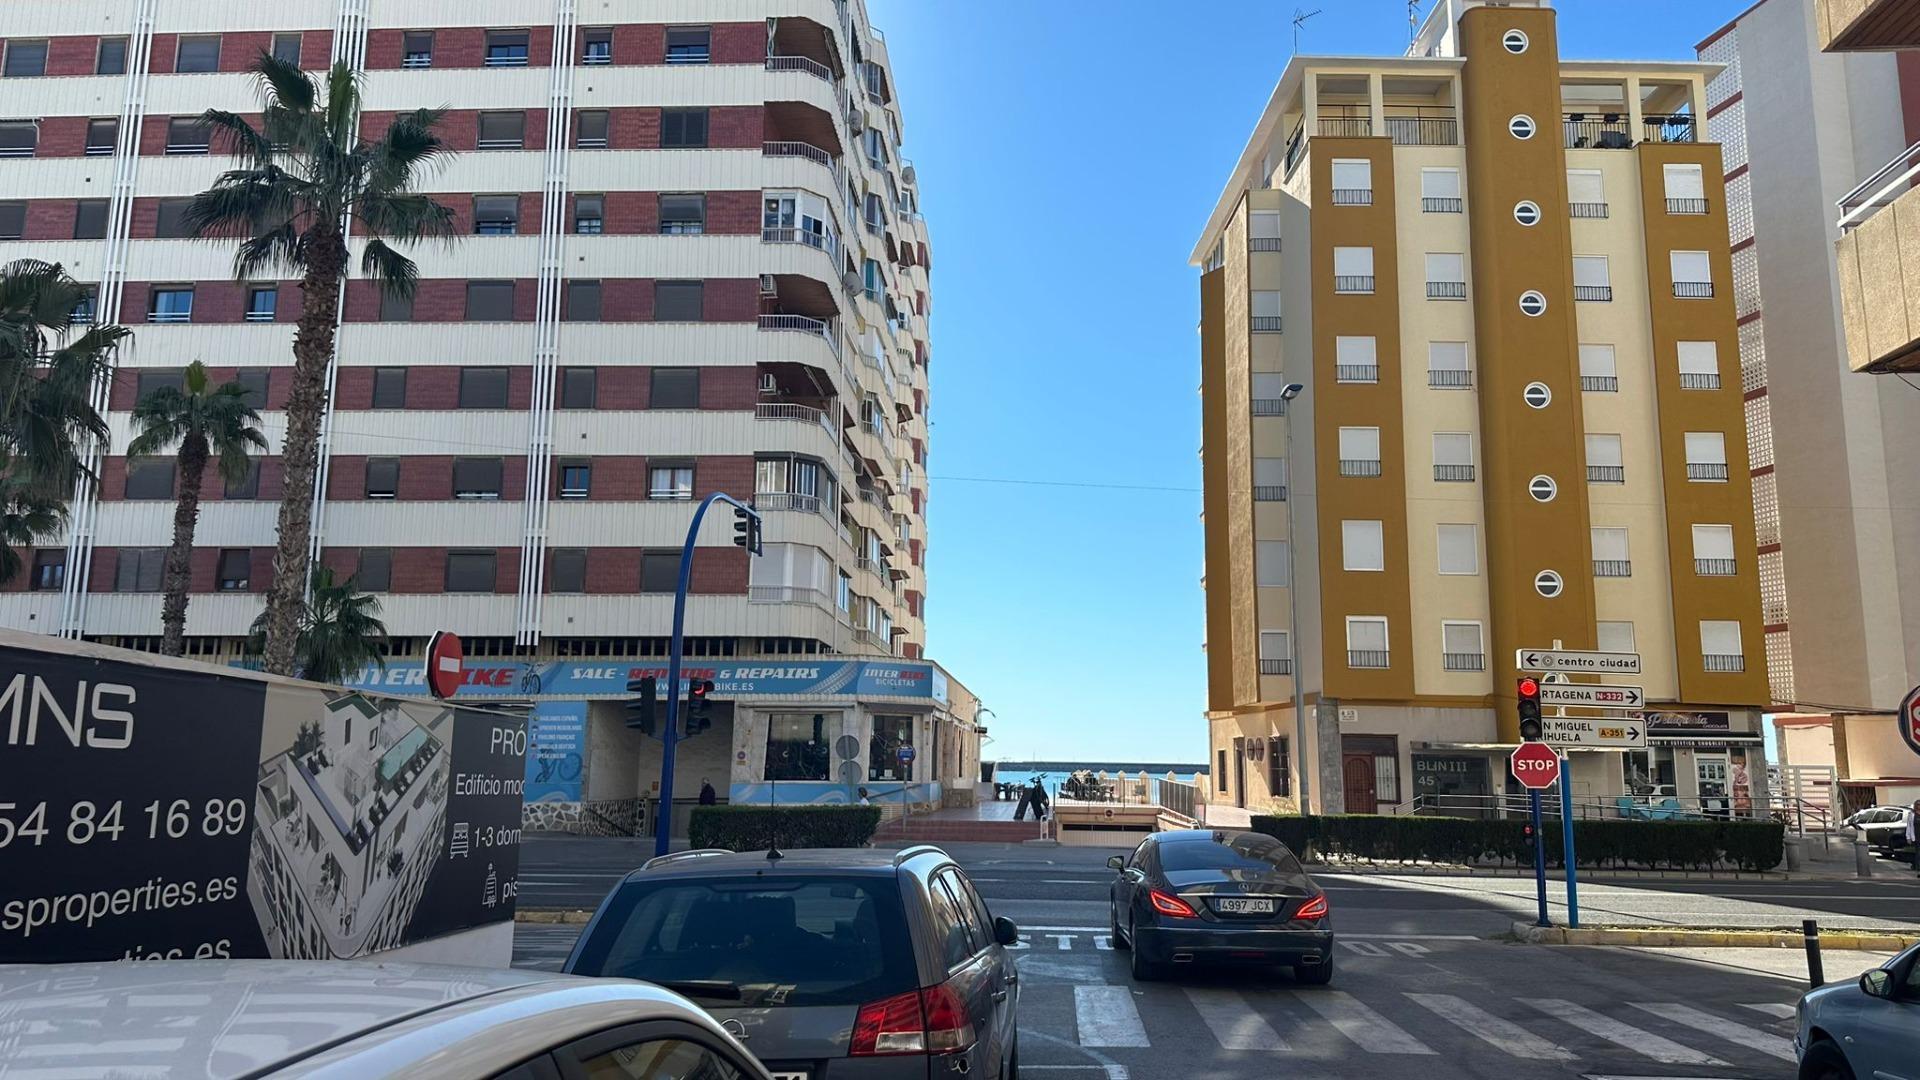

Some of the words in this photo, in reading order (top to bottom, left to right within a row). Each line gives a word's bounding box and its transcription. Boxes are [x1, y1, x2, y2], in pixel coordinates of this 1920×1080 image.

[1557, 658, 1595, 667] centro
[1599, 659, 1637, 668] ciudad
[460, 668, 516, 687] IKE
[571, 668, 618, 680] SALE
[719, 669, 732, 679] &
[734, 667, 820, 679] REPAIRS
[875, 679, 916, 688] BICICLETAS
[1541, 690, 1592, 700] RTAGENA
[1596, 693, 1623, 701] N-332
[1555, 722, 1593, 732] MIGUEL
[1543, 732, 1581, 742] IHUELA
[1600, 728, 1624, 738] A-351
[490, 723, 527, 757] PRÓ
[1517, 759, 1554, 771] STOP
[455, 773, 501, 796] Edificio
[1418, 775, 1435, 786] 45
[66, 800, 125, 845] 84
[144, 799, 191, 839] 16
[202, 798, 247, 836] 89
[474, 826, 494, 848] 1-3
[1, 876, 238, 937] sproperties.es
[1222, 900, 1248, 911] 4997
[1251, 900, 1271, 911] JCX
